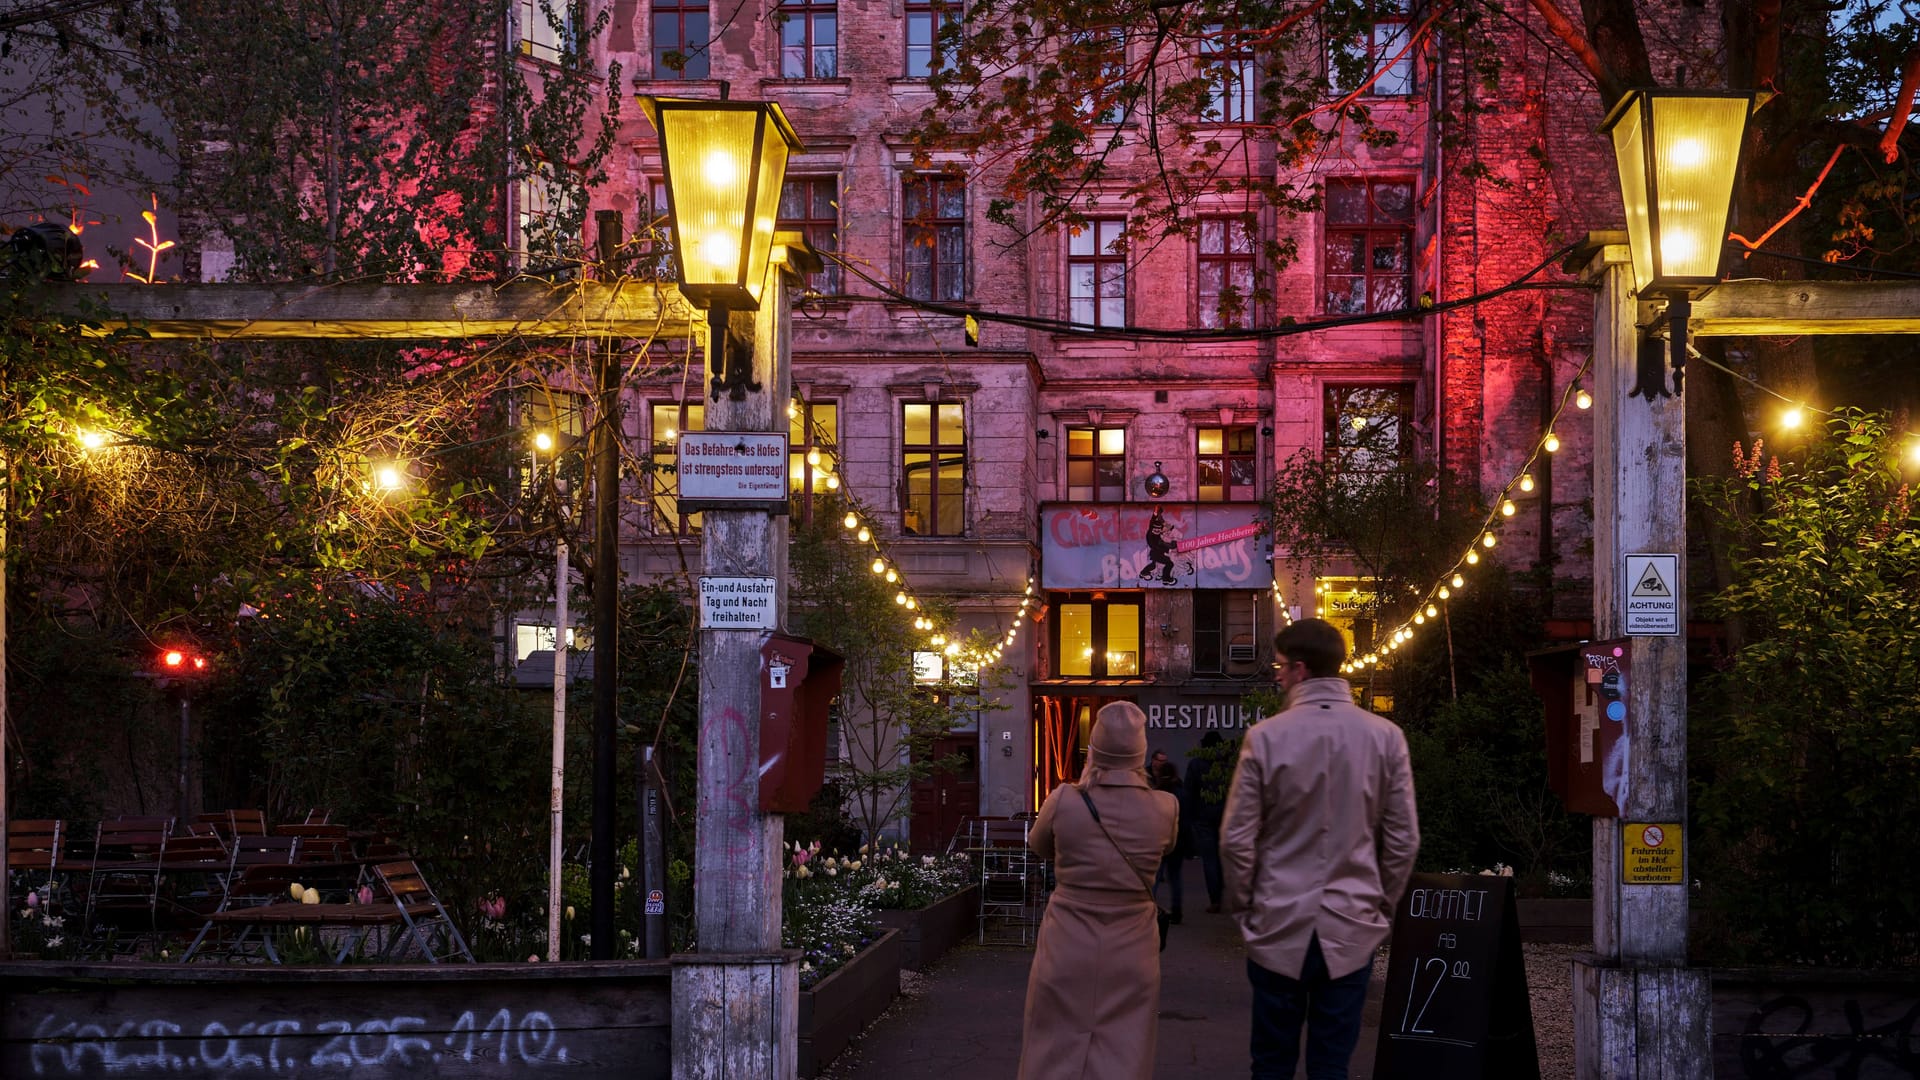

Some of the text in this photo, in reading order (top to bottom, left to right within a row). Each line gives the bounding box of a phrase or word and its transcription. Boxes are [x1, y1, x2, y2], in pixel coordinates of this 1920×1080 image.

[685, 442, 701, 456] Das
[757, 444, 780, 457] Hofes
[682, 462, 783, 479] ist strengstens untersagt
[1182, 540, 1196, 550] 100
[1196, 535, 1217, 549] Jahre
[736, 582, 774, 594] Ausfahrt
[705, 595, 768, 609] Tag und Nacht
[1629, 601, 1674, 609] ACHTUNG!
[1634, 616, 1655, 624] Objekt
[1631, 847, 1676, 855] Fahrräder
[1638, 856, 1649, 864] im
[1633, 865, 1672, 873] abstellen
[1633, 874, 1672, 882] verboten
[1437, 932, 1457, 949] AB
